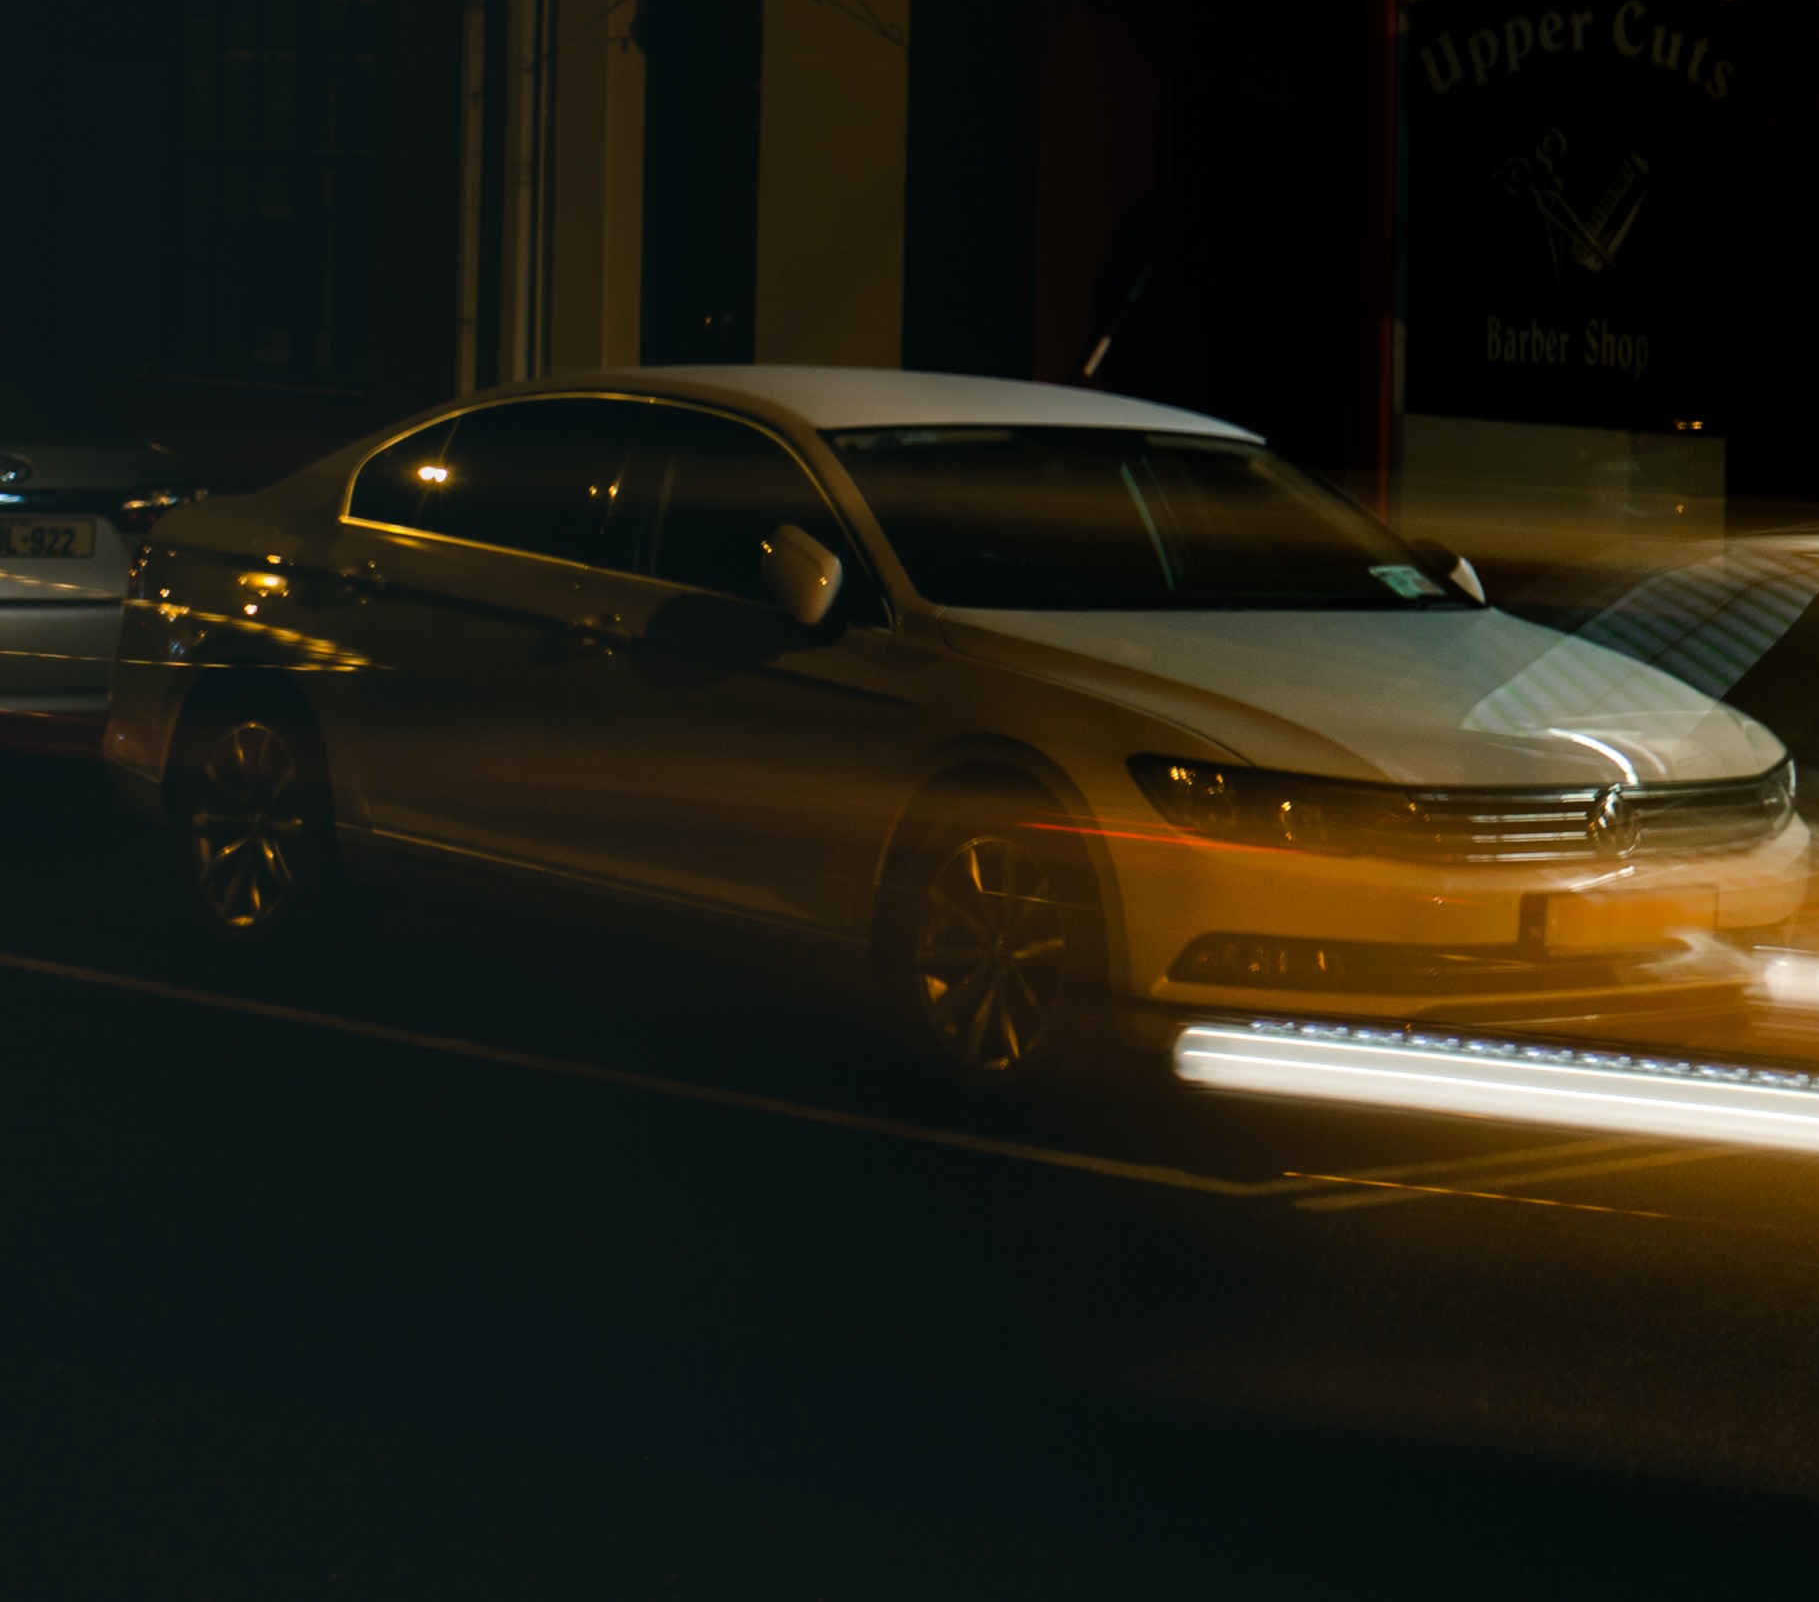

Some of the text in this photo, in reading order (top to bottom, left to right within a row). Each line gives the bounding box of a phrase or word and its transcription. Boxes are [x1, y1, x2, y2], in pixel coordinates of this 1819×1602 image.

[1417, 6, 1595, 97] Upper
[1485, 312, 1651, 382] Barber Shop
